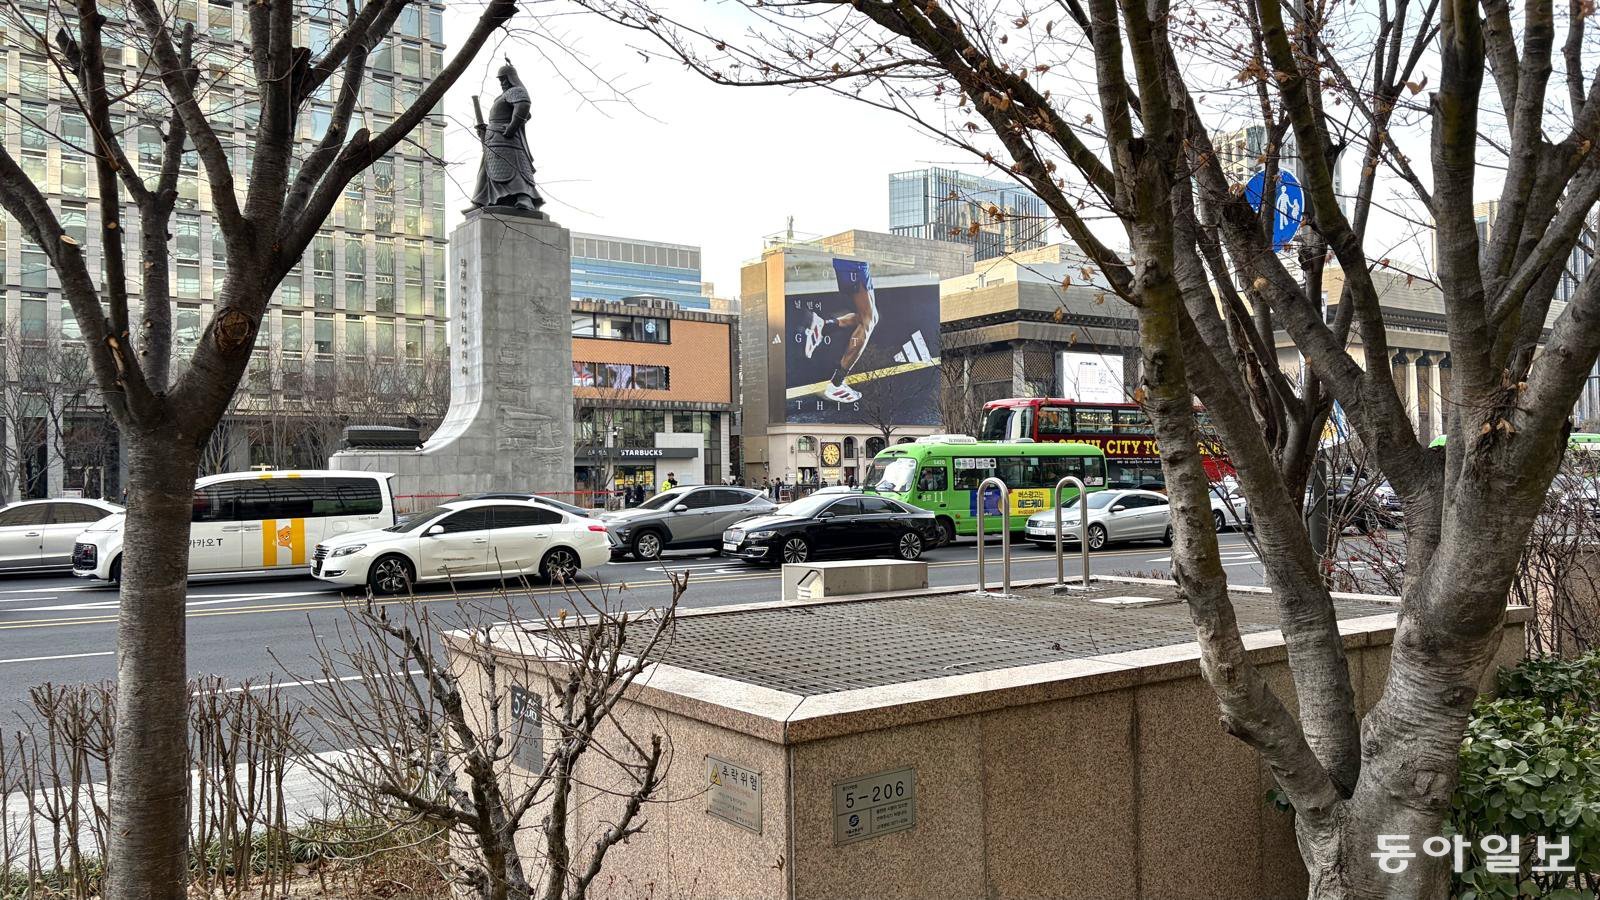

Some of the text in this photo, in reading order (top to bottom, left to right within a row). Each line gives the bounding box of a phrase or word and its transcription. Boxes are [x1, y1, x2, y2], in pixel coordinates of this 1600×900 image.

[794, 333, 860, 348] GOT
[795, 400, 860, 412] THIS
[1106, 439, 1142, 455] CITY
[1143, 439, 1162, 455] TO
[933, 491, 944, 503] 11
[1017, 490, 1044, 499] 버스광고는
[216, 538, 223, 547] T
[722, 765, 757, 791] 추락위험
[845, 780, 904, 809] 5-206
